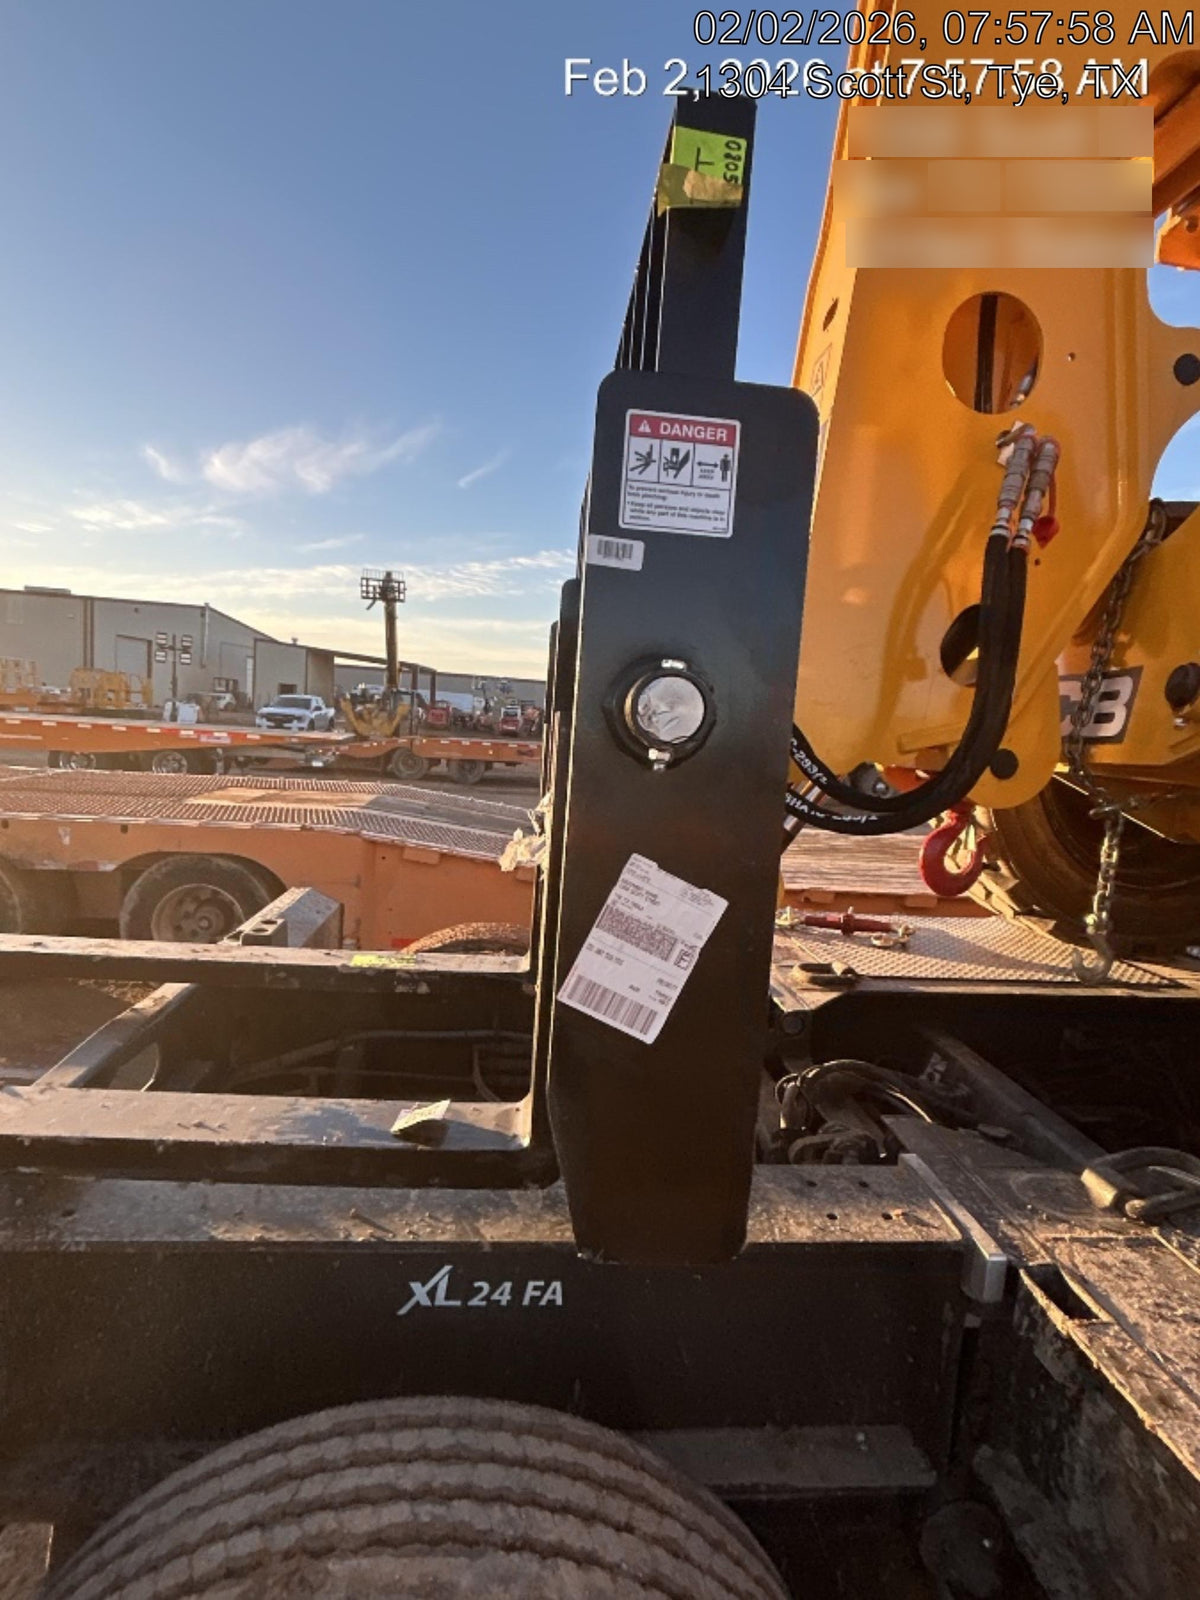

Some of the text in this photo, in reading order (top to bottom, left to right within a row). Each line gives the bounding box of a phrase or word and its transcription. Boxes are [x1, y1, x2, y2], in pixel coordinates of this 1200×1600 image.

[660, 422, 728, 441] DANGER
[397, 1265, 563, 1316] XL 24 FA
